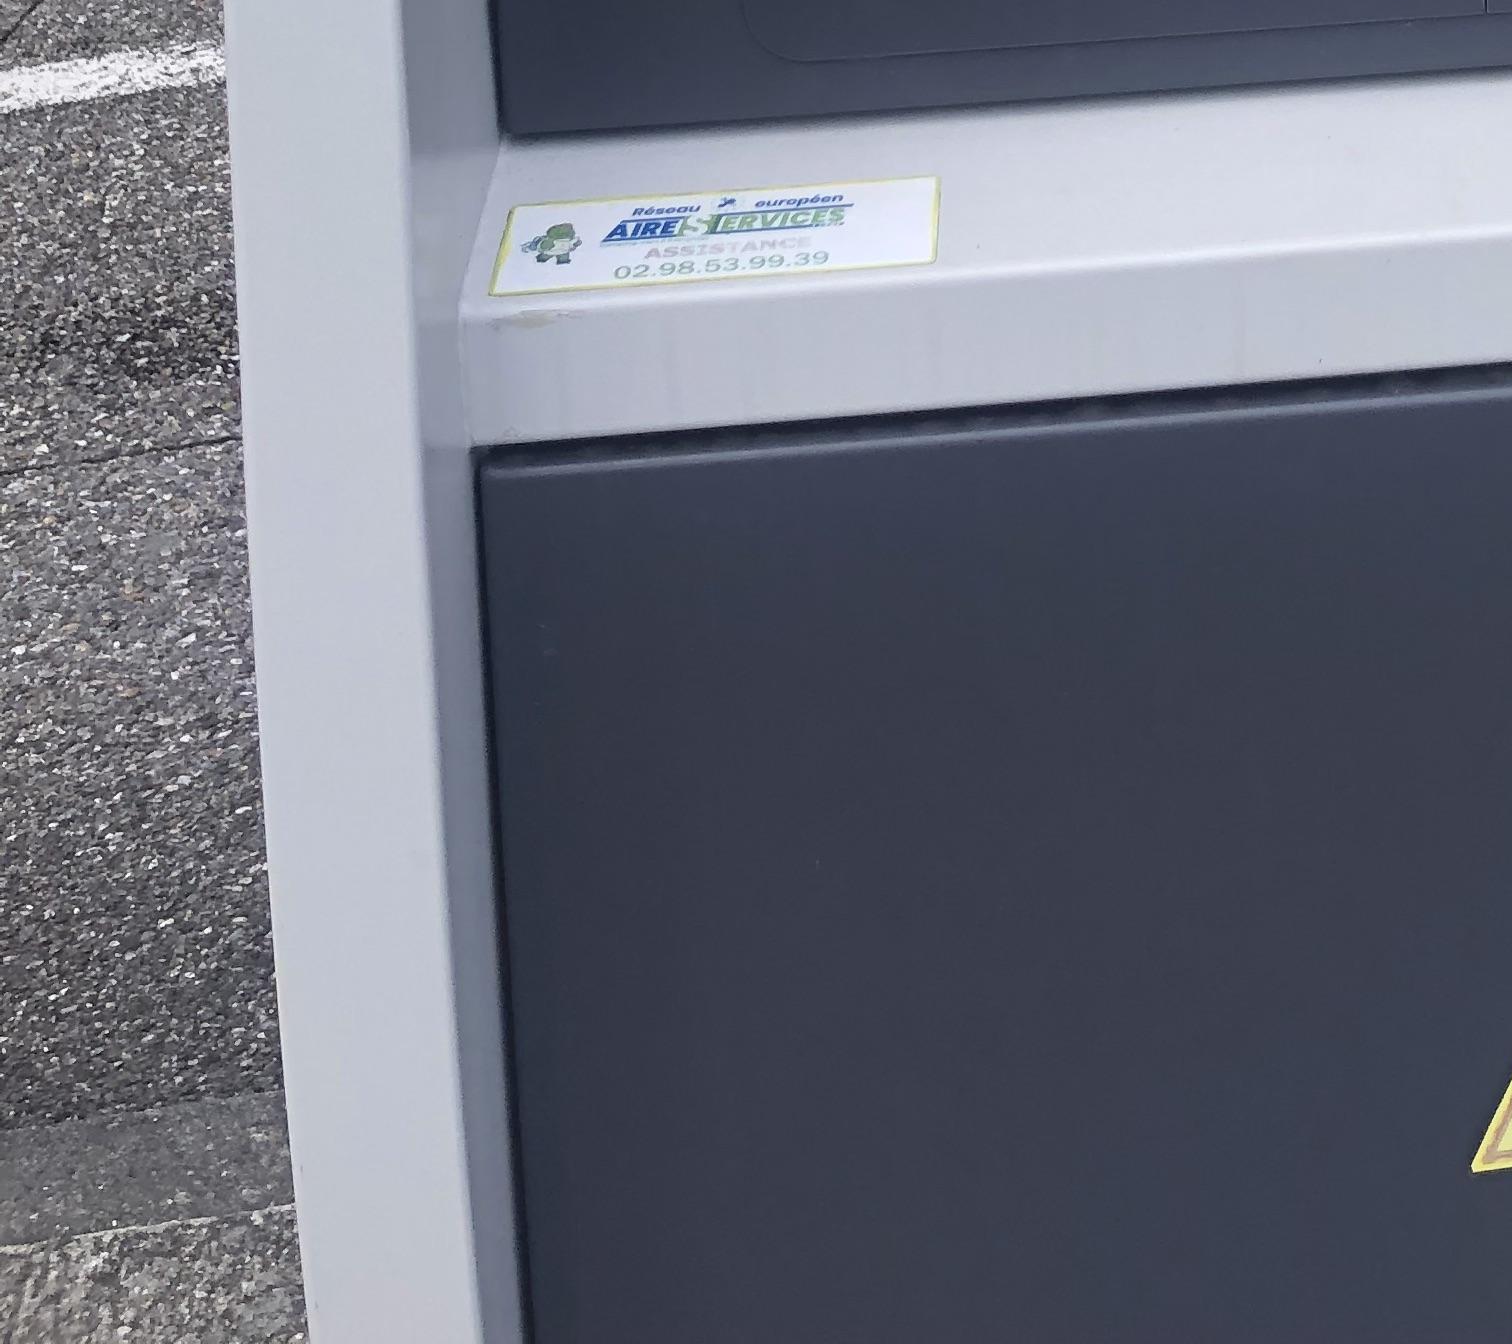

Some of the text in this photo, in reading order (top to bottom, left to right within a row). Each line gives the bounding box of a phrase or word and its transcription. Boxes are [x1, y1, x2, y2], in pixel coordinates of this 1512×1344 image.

[632, 194, 844, 217] Réseau européen
[643, 235, 814, 260] ASSISTANCE
[613, 250, 830, 281] 02.98.53.99.39
